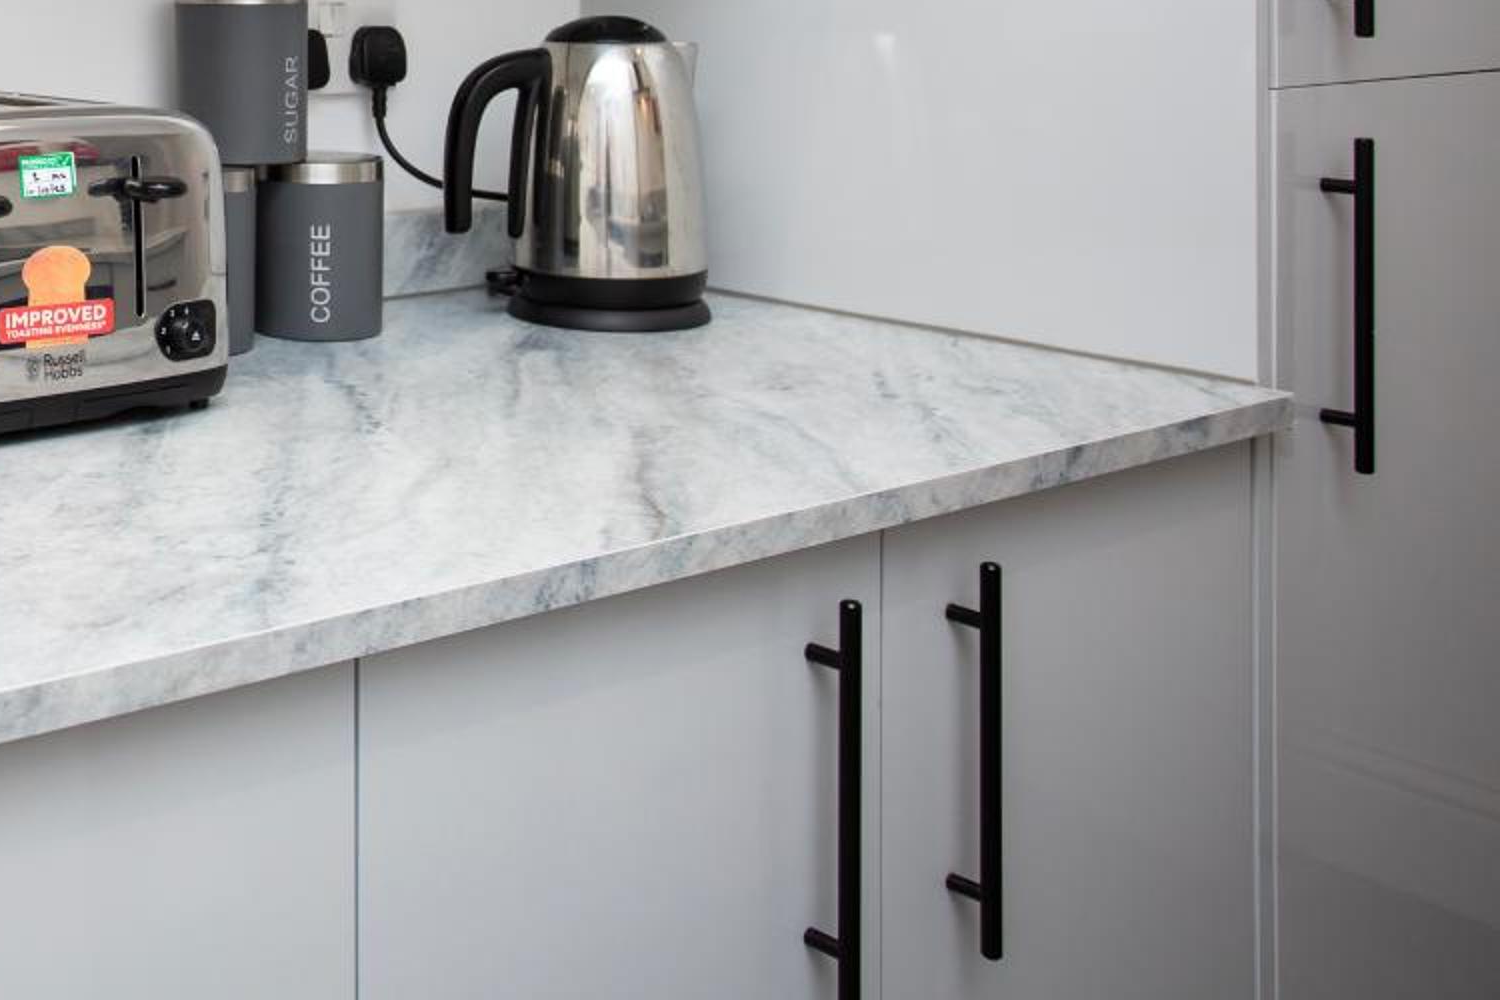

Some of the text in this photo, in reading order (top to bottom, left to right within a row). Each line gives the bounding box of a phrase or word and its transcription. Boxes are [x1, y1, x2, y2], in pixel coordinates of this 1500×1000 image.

[285, 56, 299, 145] SUGAR
[310, 223, 332, 324] COFFEE
[5, 305, 106, 329] IMPROVED
[44, 350, 85, 368] Russell
[44, 366, 83, 381] Hobbs
